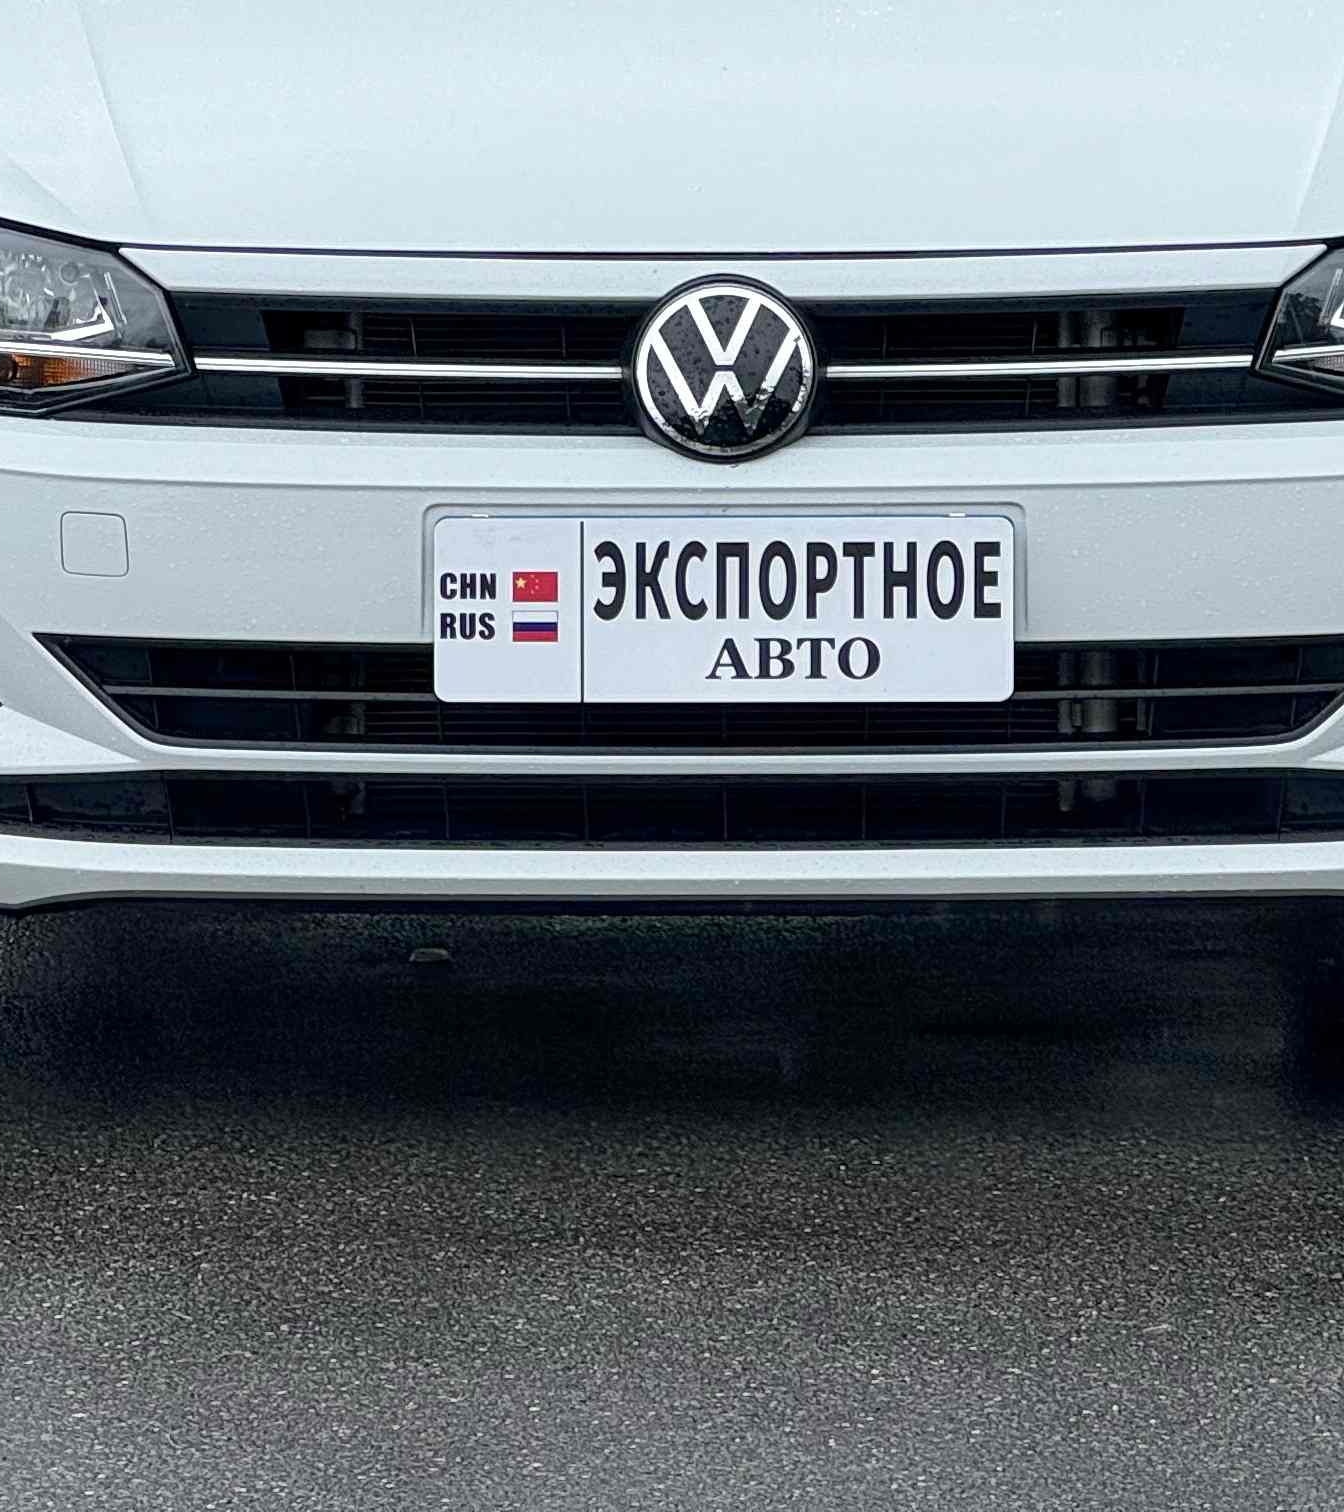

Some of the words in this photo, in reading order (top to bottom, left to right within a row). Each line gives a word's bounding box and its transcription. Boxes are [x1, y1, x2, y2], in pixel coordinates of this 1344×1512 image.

[641, 287, 806, 440] VW
[439, 572, 497, 600] CHN
[593, 540, 1002, 621] ЭКСПОРТНОЕ
[439, 612, 496, 641] RUS
[705, 636, 881, 680] АВТО
